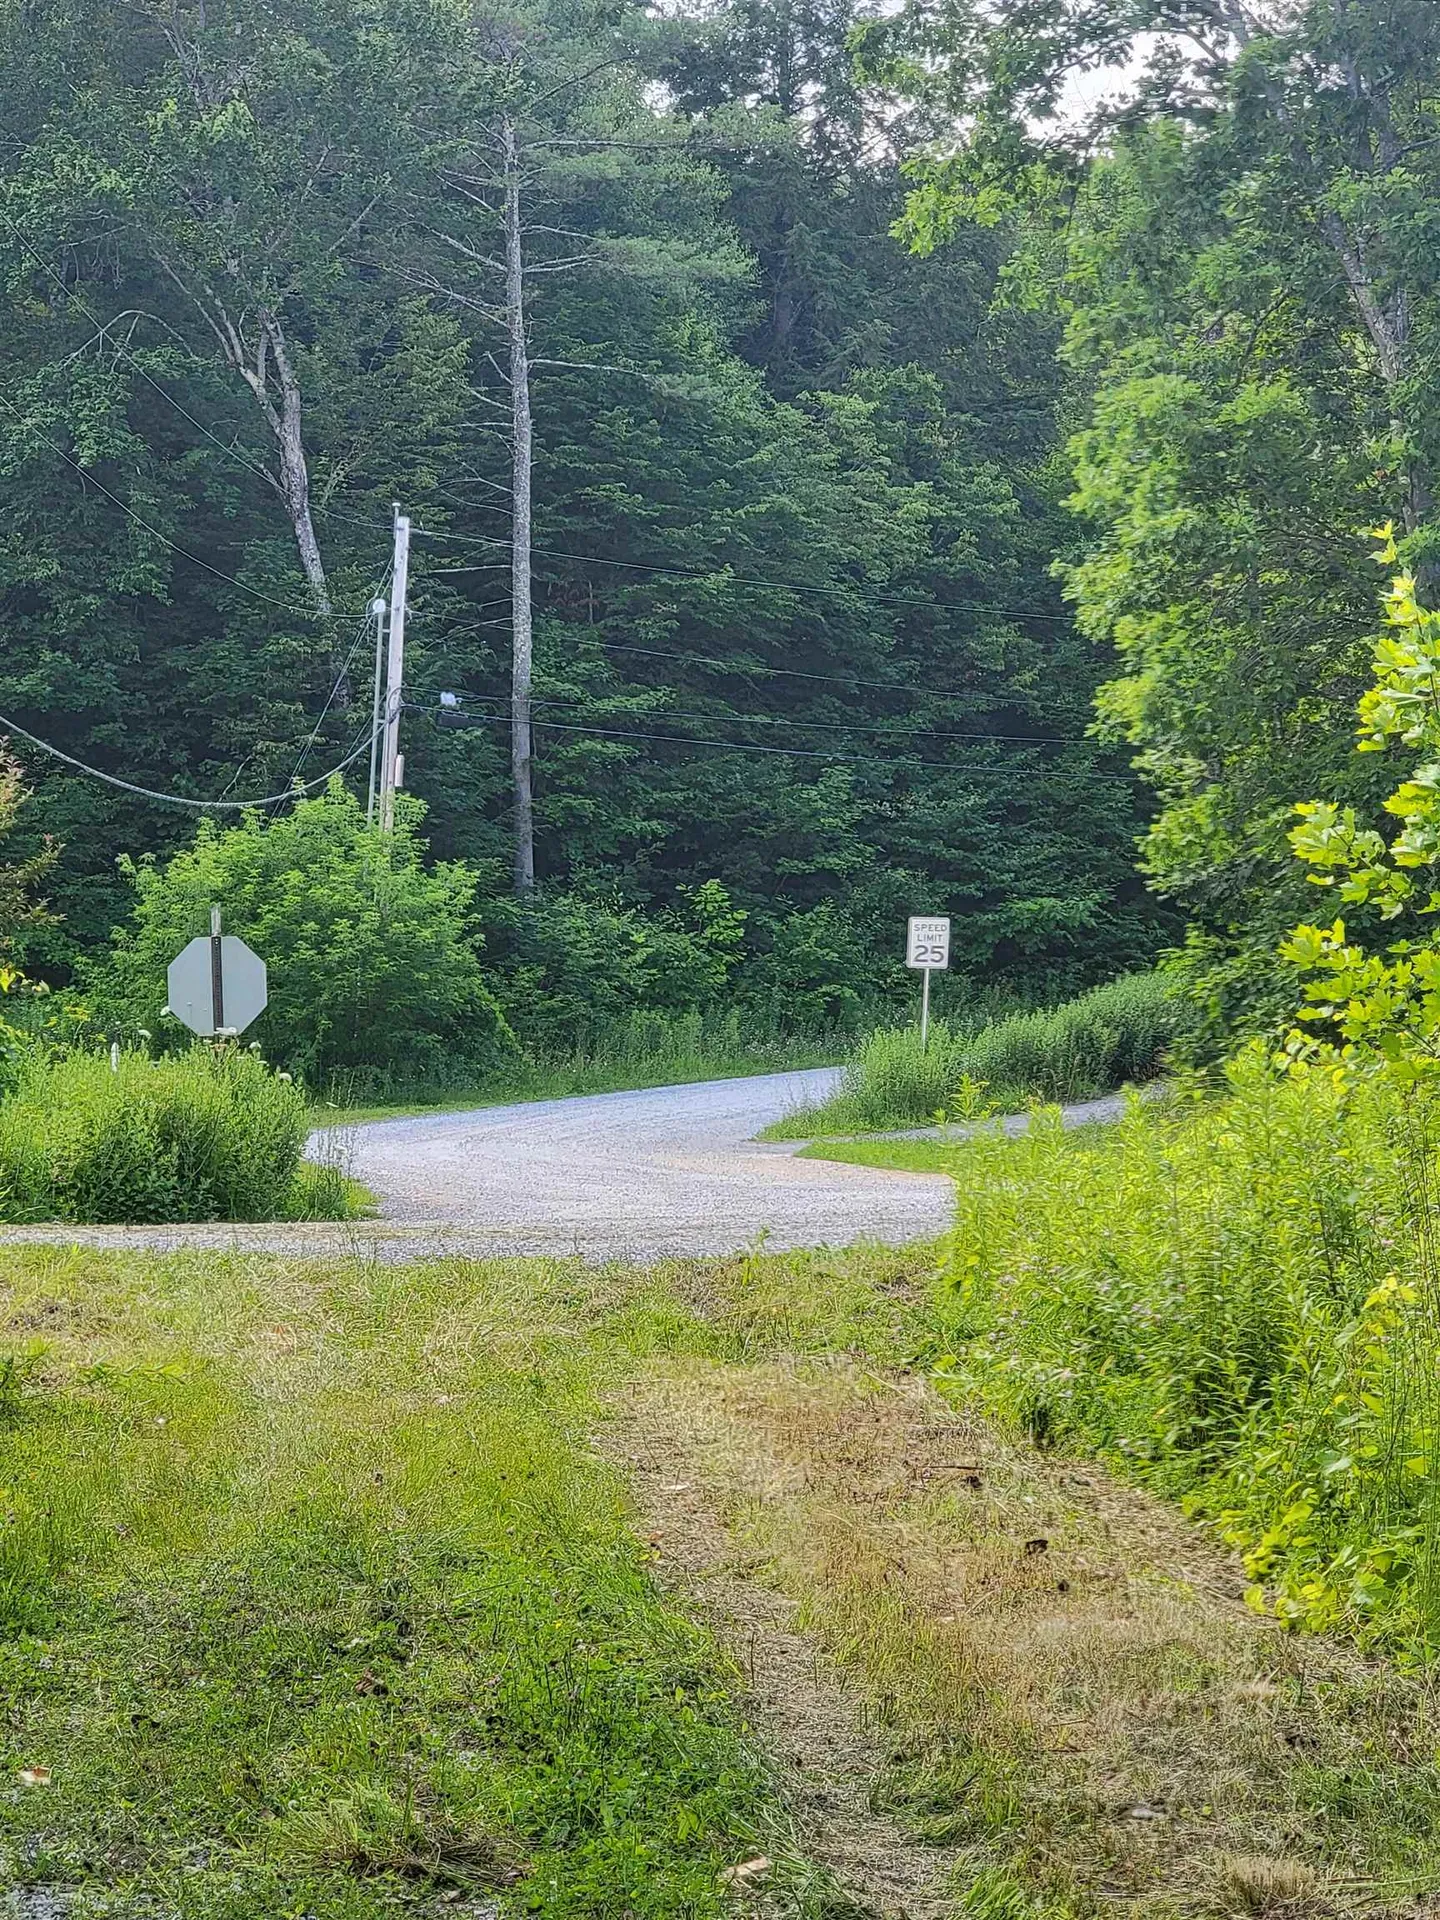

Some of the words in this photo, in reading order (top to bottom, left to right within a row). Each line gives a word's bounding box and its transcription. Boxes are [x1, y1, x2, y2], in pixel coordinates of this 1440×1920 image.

[913, 923, 947, 931] SPEED
[917, 934, 943, 942] LIMIT
[913, 945, 945, 963] 25
